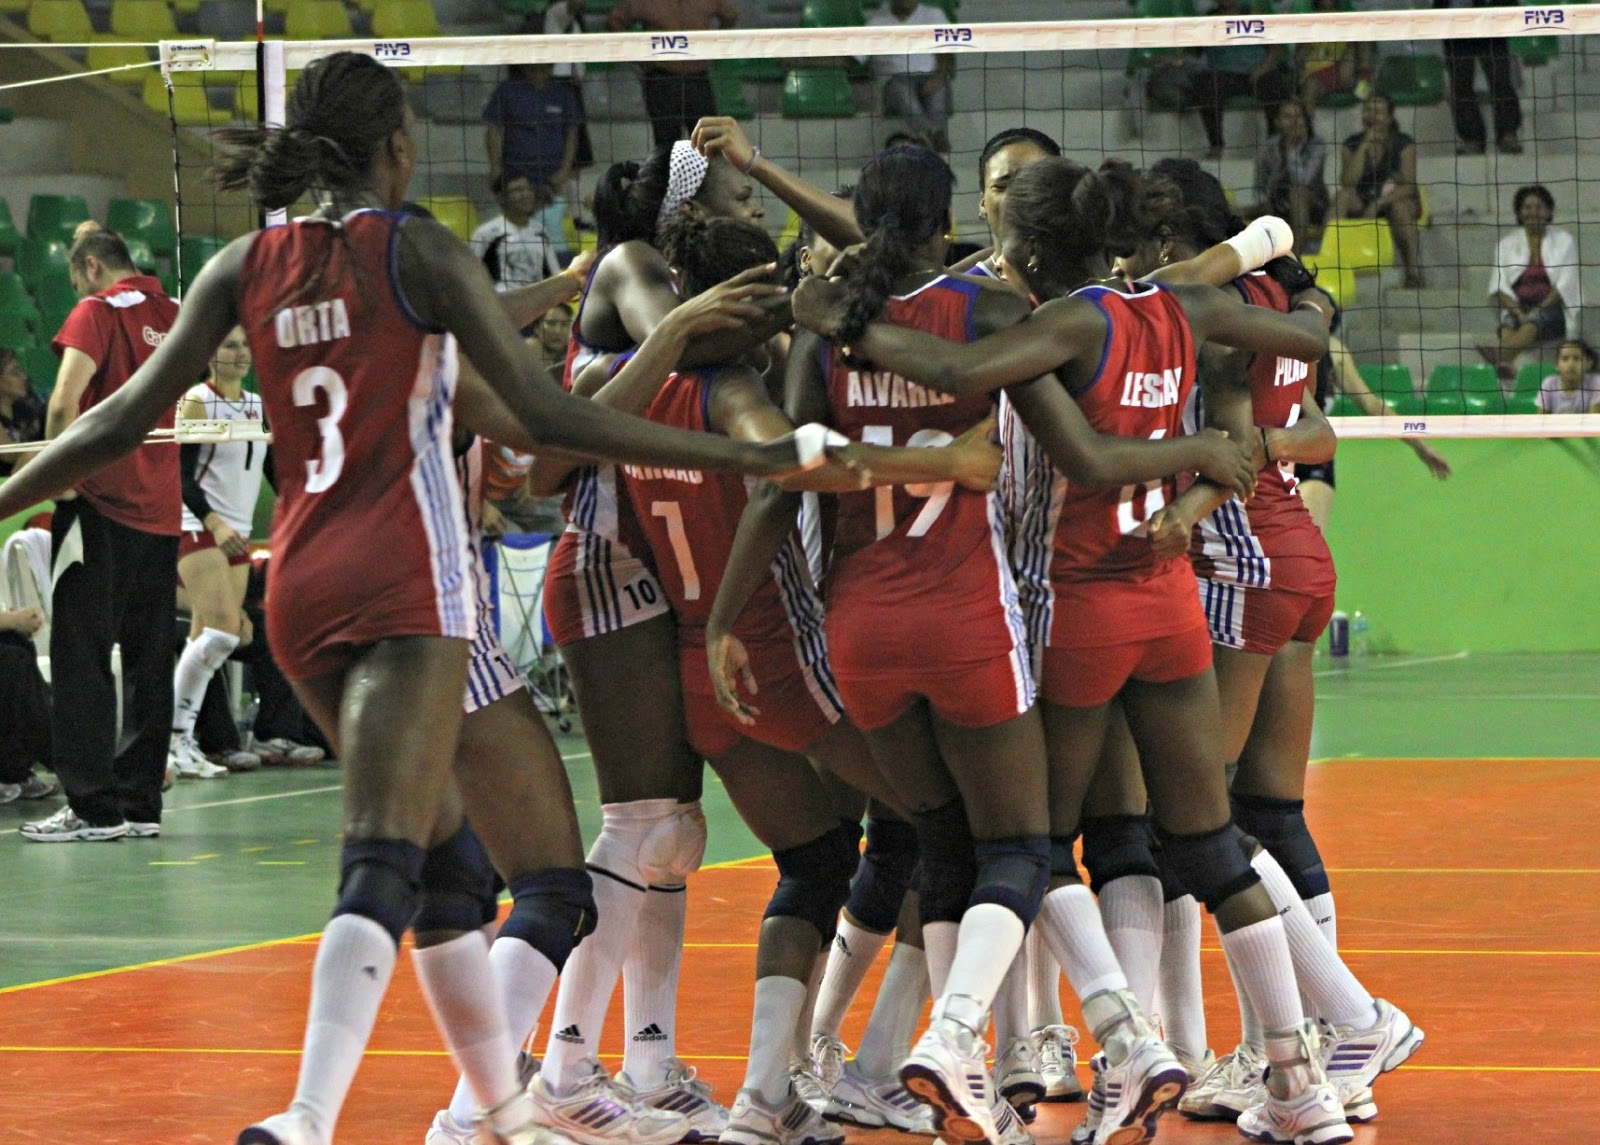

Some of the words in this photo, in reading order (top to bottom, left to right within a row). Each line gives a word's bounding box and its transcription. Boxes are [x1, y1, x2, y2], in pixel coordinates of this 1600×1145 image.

[1525, 9, 1565, 25] FIVB
[1225, 20, 1265, 34] FIVB
[651, 35, 689, 49] FIVB
[934, 28, 972, 42] FIVB
[374, 43, 411, 56] FIVB
[275, 299, 351, 348] ORTA
[292, 366, 348, 494] 3
[1404, 422, 1426, 431] FIVB
[651, 501, 701, 600] 1
[623, 579, 657, 610] 10
[633, 1034, 668, 1042] adidas
